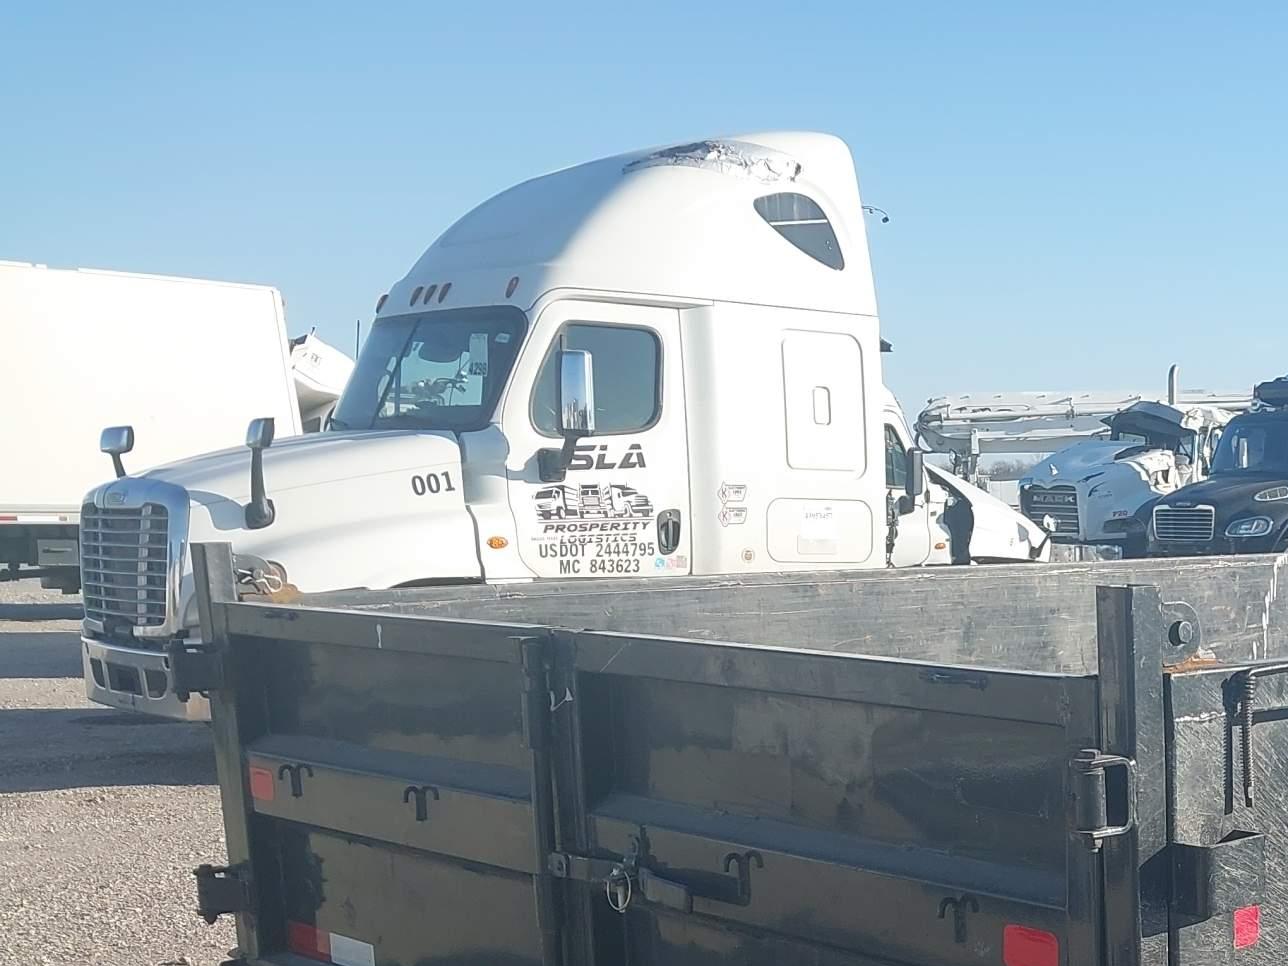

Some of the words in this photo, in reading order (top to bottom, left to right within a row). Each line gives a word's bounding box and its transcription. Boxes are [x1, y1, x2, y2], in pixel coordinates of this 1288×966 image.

[411, 470, 456, 496] 001
[543, 521, 650, 534] PROSPERITY
[559, 532, 637, 545] LOGISTICS
[538, 542, 587, 559] USDOT
[595, 541, 656, 557] 2444795
[559, 559, 581, 575] MC
[589, 558, 641, 574] 843623
